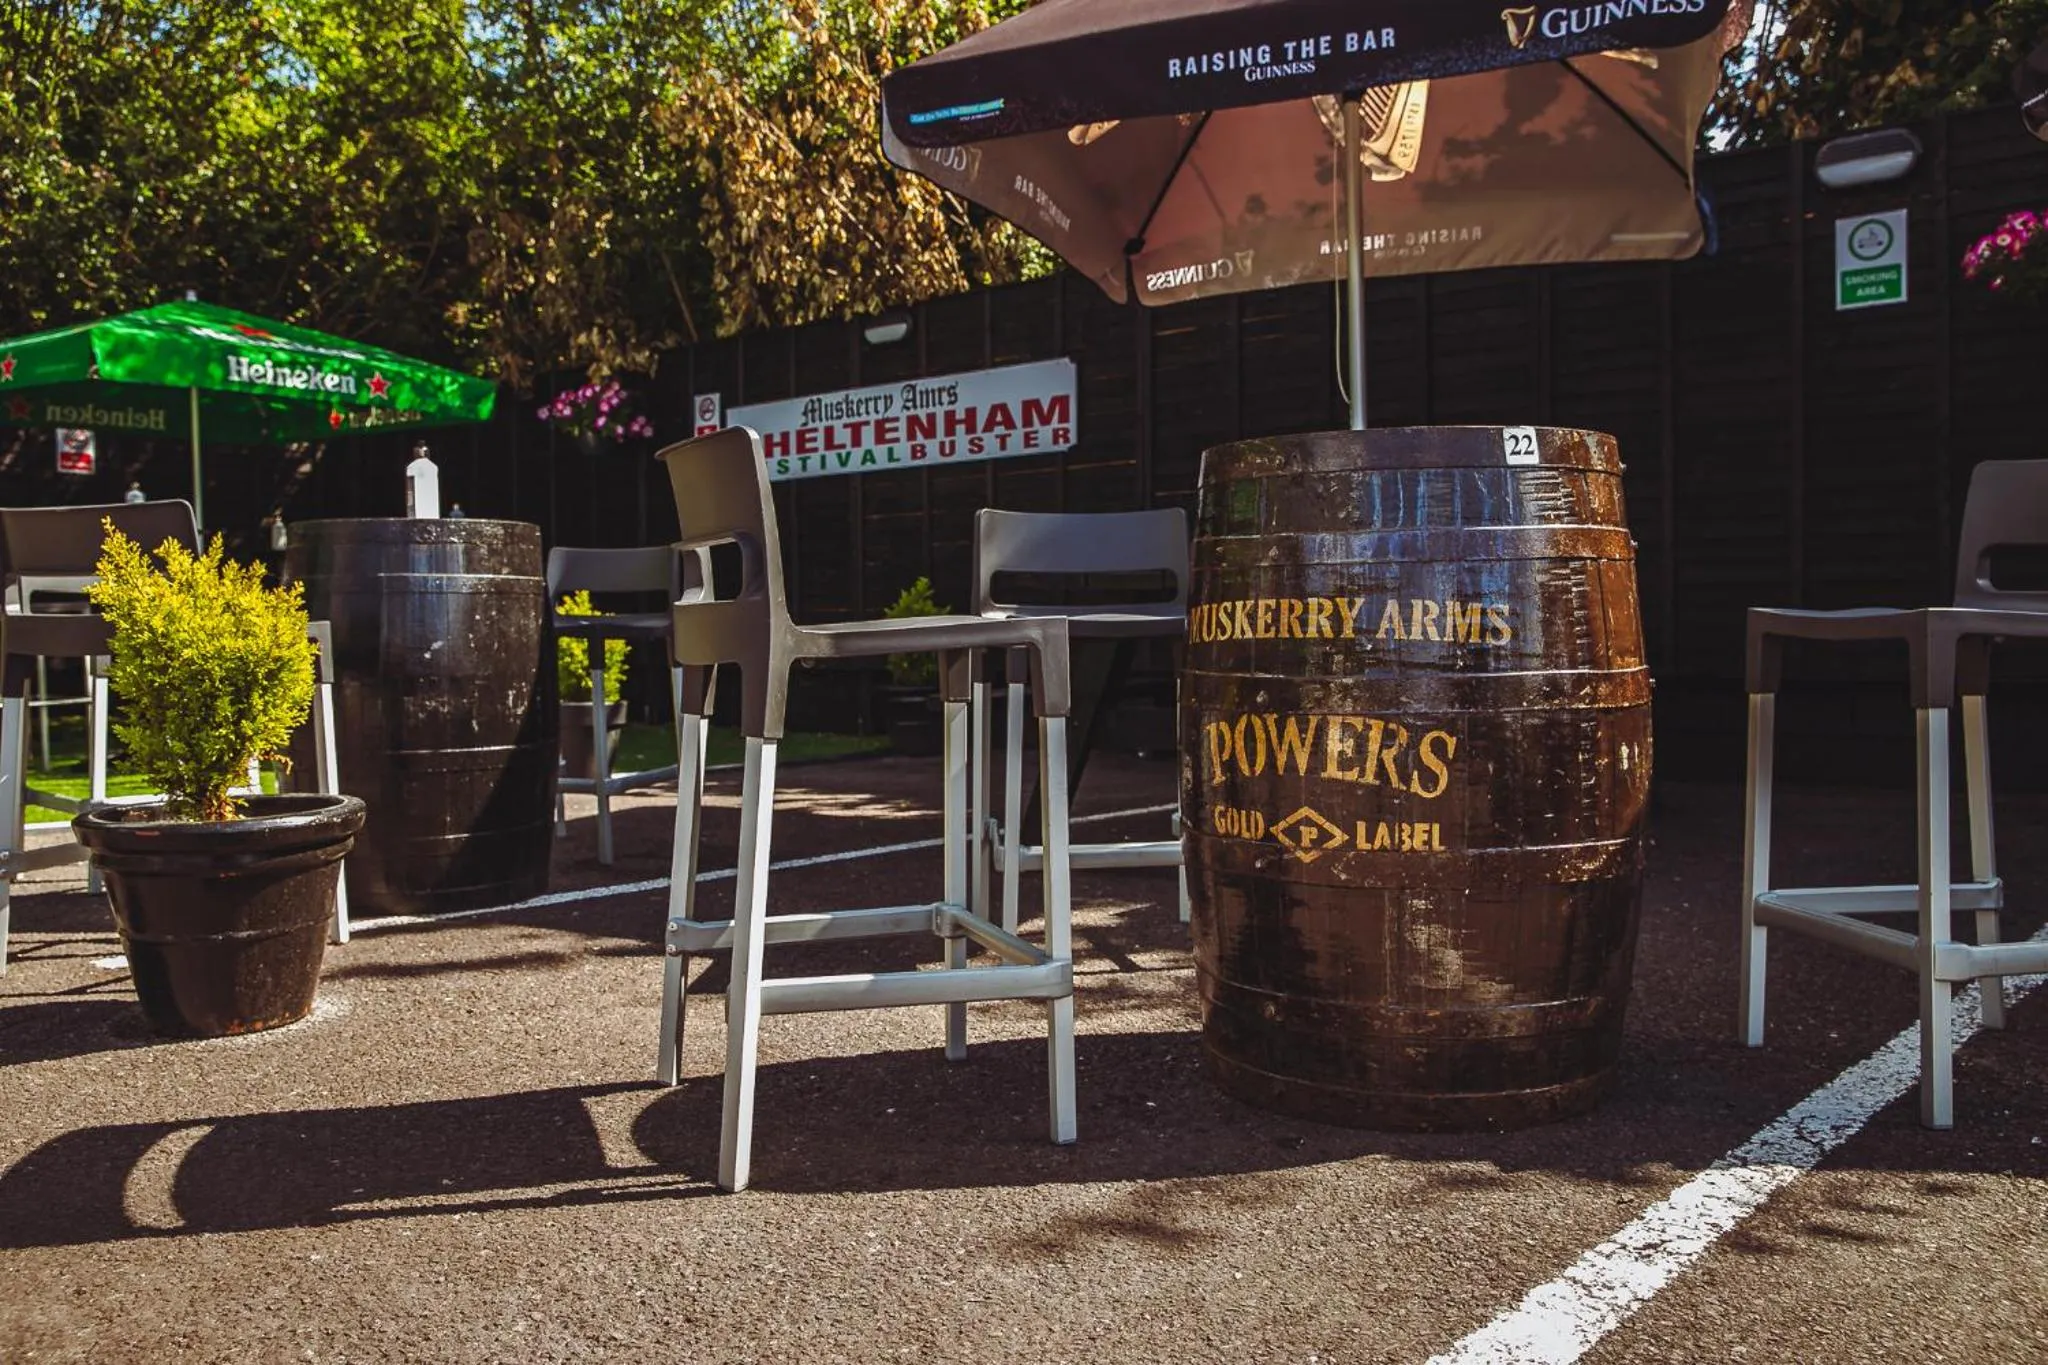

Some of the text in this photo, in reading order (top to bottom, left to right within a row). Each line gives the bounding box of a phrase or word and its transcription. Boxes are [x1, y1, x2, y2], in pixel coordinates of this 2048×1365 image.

[1541, 0, 1704, 38] GUINNESS
[1168, 27, 1396, 79] RAISING THE BAR
[1244, 60, 1316, 82] GUINNESS
[1845, 270, 1898, 287] SMOKING
[1856, 285, 1886, 297] AREA
[227, 354, 357, 395] Heineken
[763, 394, 1070, 459] HELTENHAM
[801, 393, 893, 427] Muskerry
[1506, 434, 1535, 456] 22
[1189, 597, 1512, 646] MUSKERRY ARMS
[1206, 712, 1457, 798] POWERS
[1214, 805, 1265, 840] GOLD
[1356, 820, 1445, 852] LABEL
